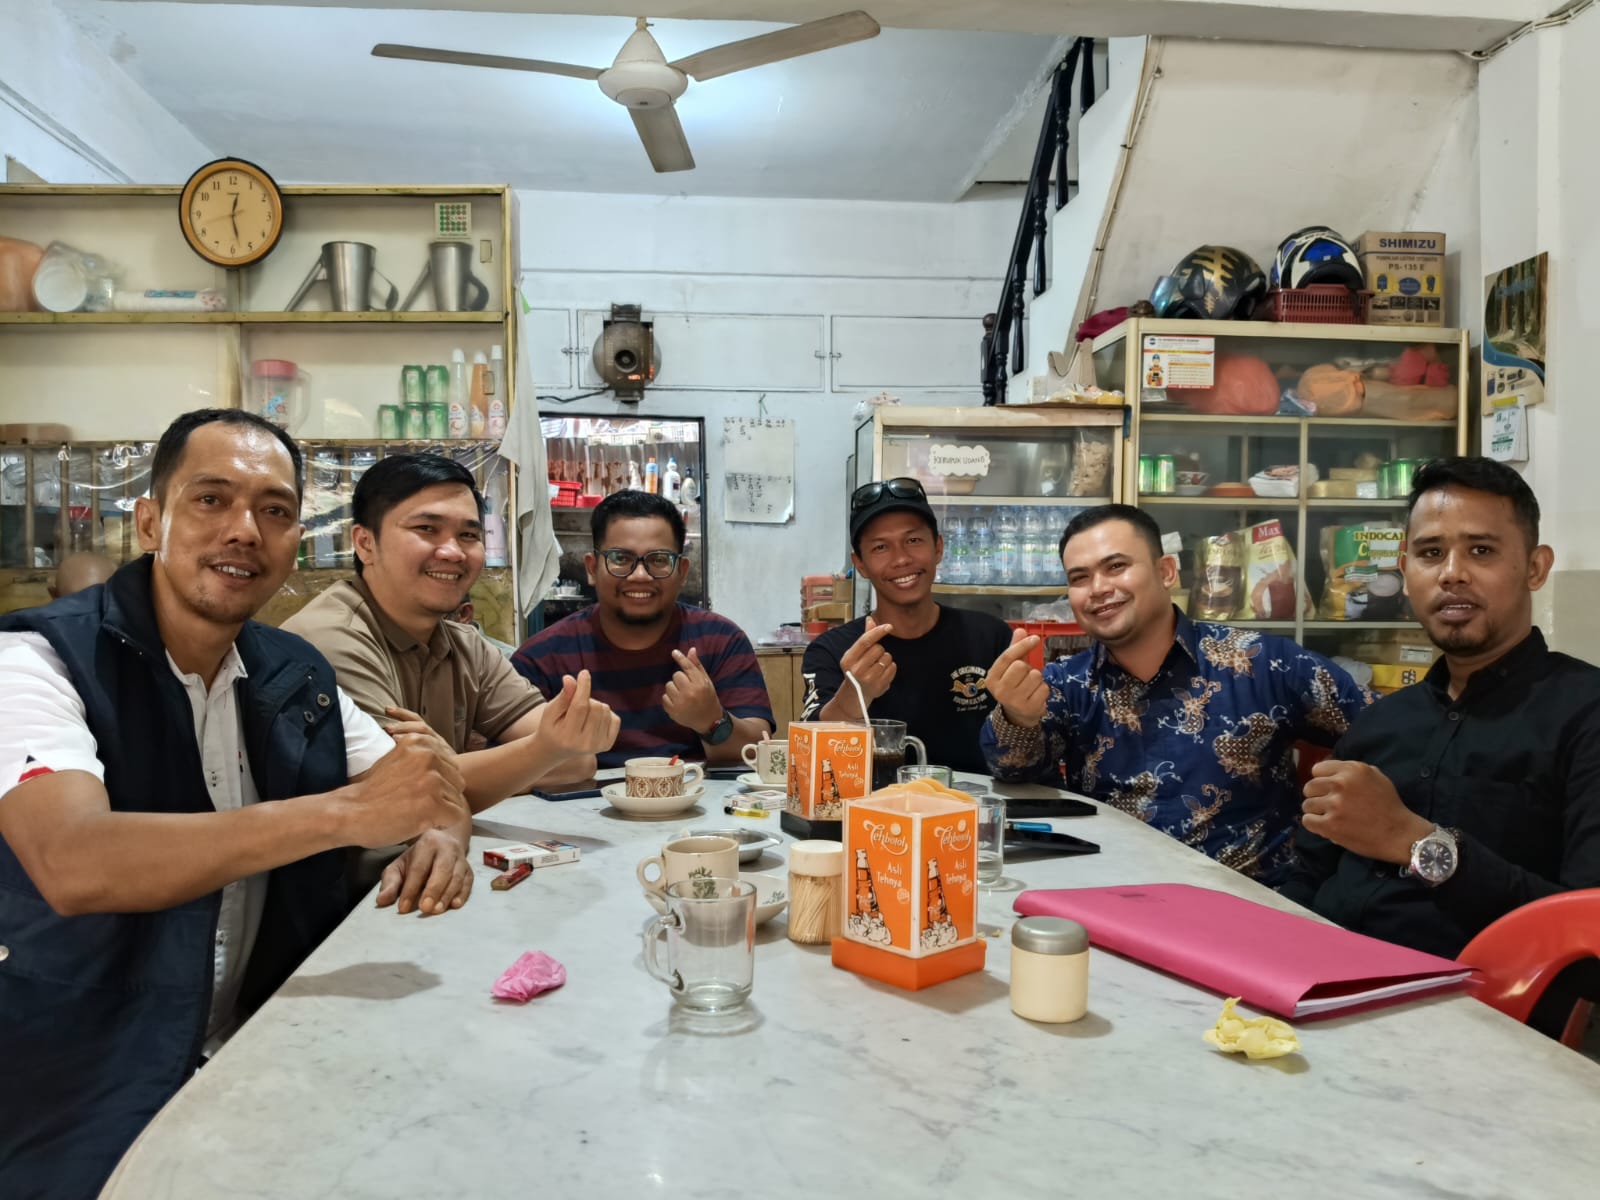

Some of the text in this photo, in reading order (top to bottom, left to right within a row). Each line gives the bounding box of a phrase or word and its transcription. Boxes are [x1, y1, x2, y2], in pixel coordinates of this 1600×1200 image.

[229, 175, 238, 185] 12
[213, 181, 221, 191] 11
[249, 181, 253, 190] 1
[201, 192, 210, 201] 10
[261, 193, 267, 203] 2
[196, 210, 202, 219] 9
[265, 211, 272, 222] 3
[201, 227, 207, 237] 8
[261, 229, 266, 238] 4
[247, 241, 253, 251] 5
[1379, 238, 1436, 249] SHIMIZU
[230, 245, 236, 255] 6
[1388, 263, 1418, 271] PS-135
[963, 455, 985, 465] UDANG
[1258, 526, 1280, 538] Max
[887, 861, 902, 875] Asli
[954, 858, 967, 871] Asli
[876, 871, 902, 889] Tehnya
